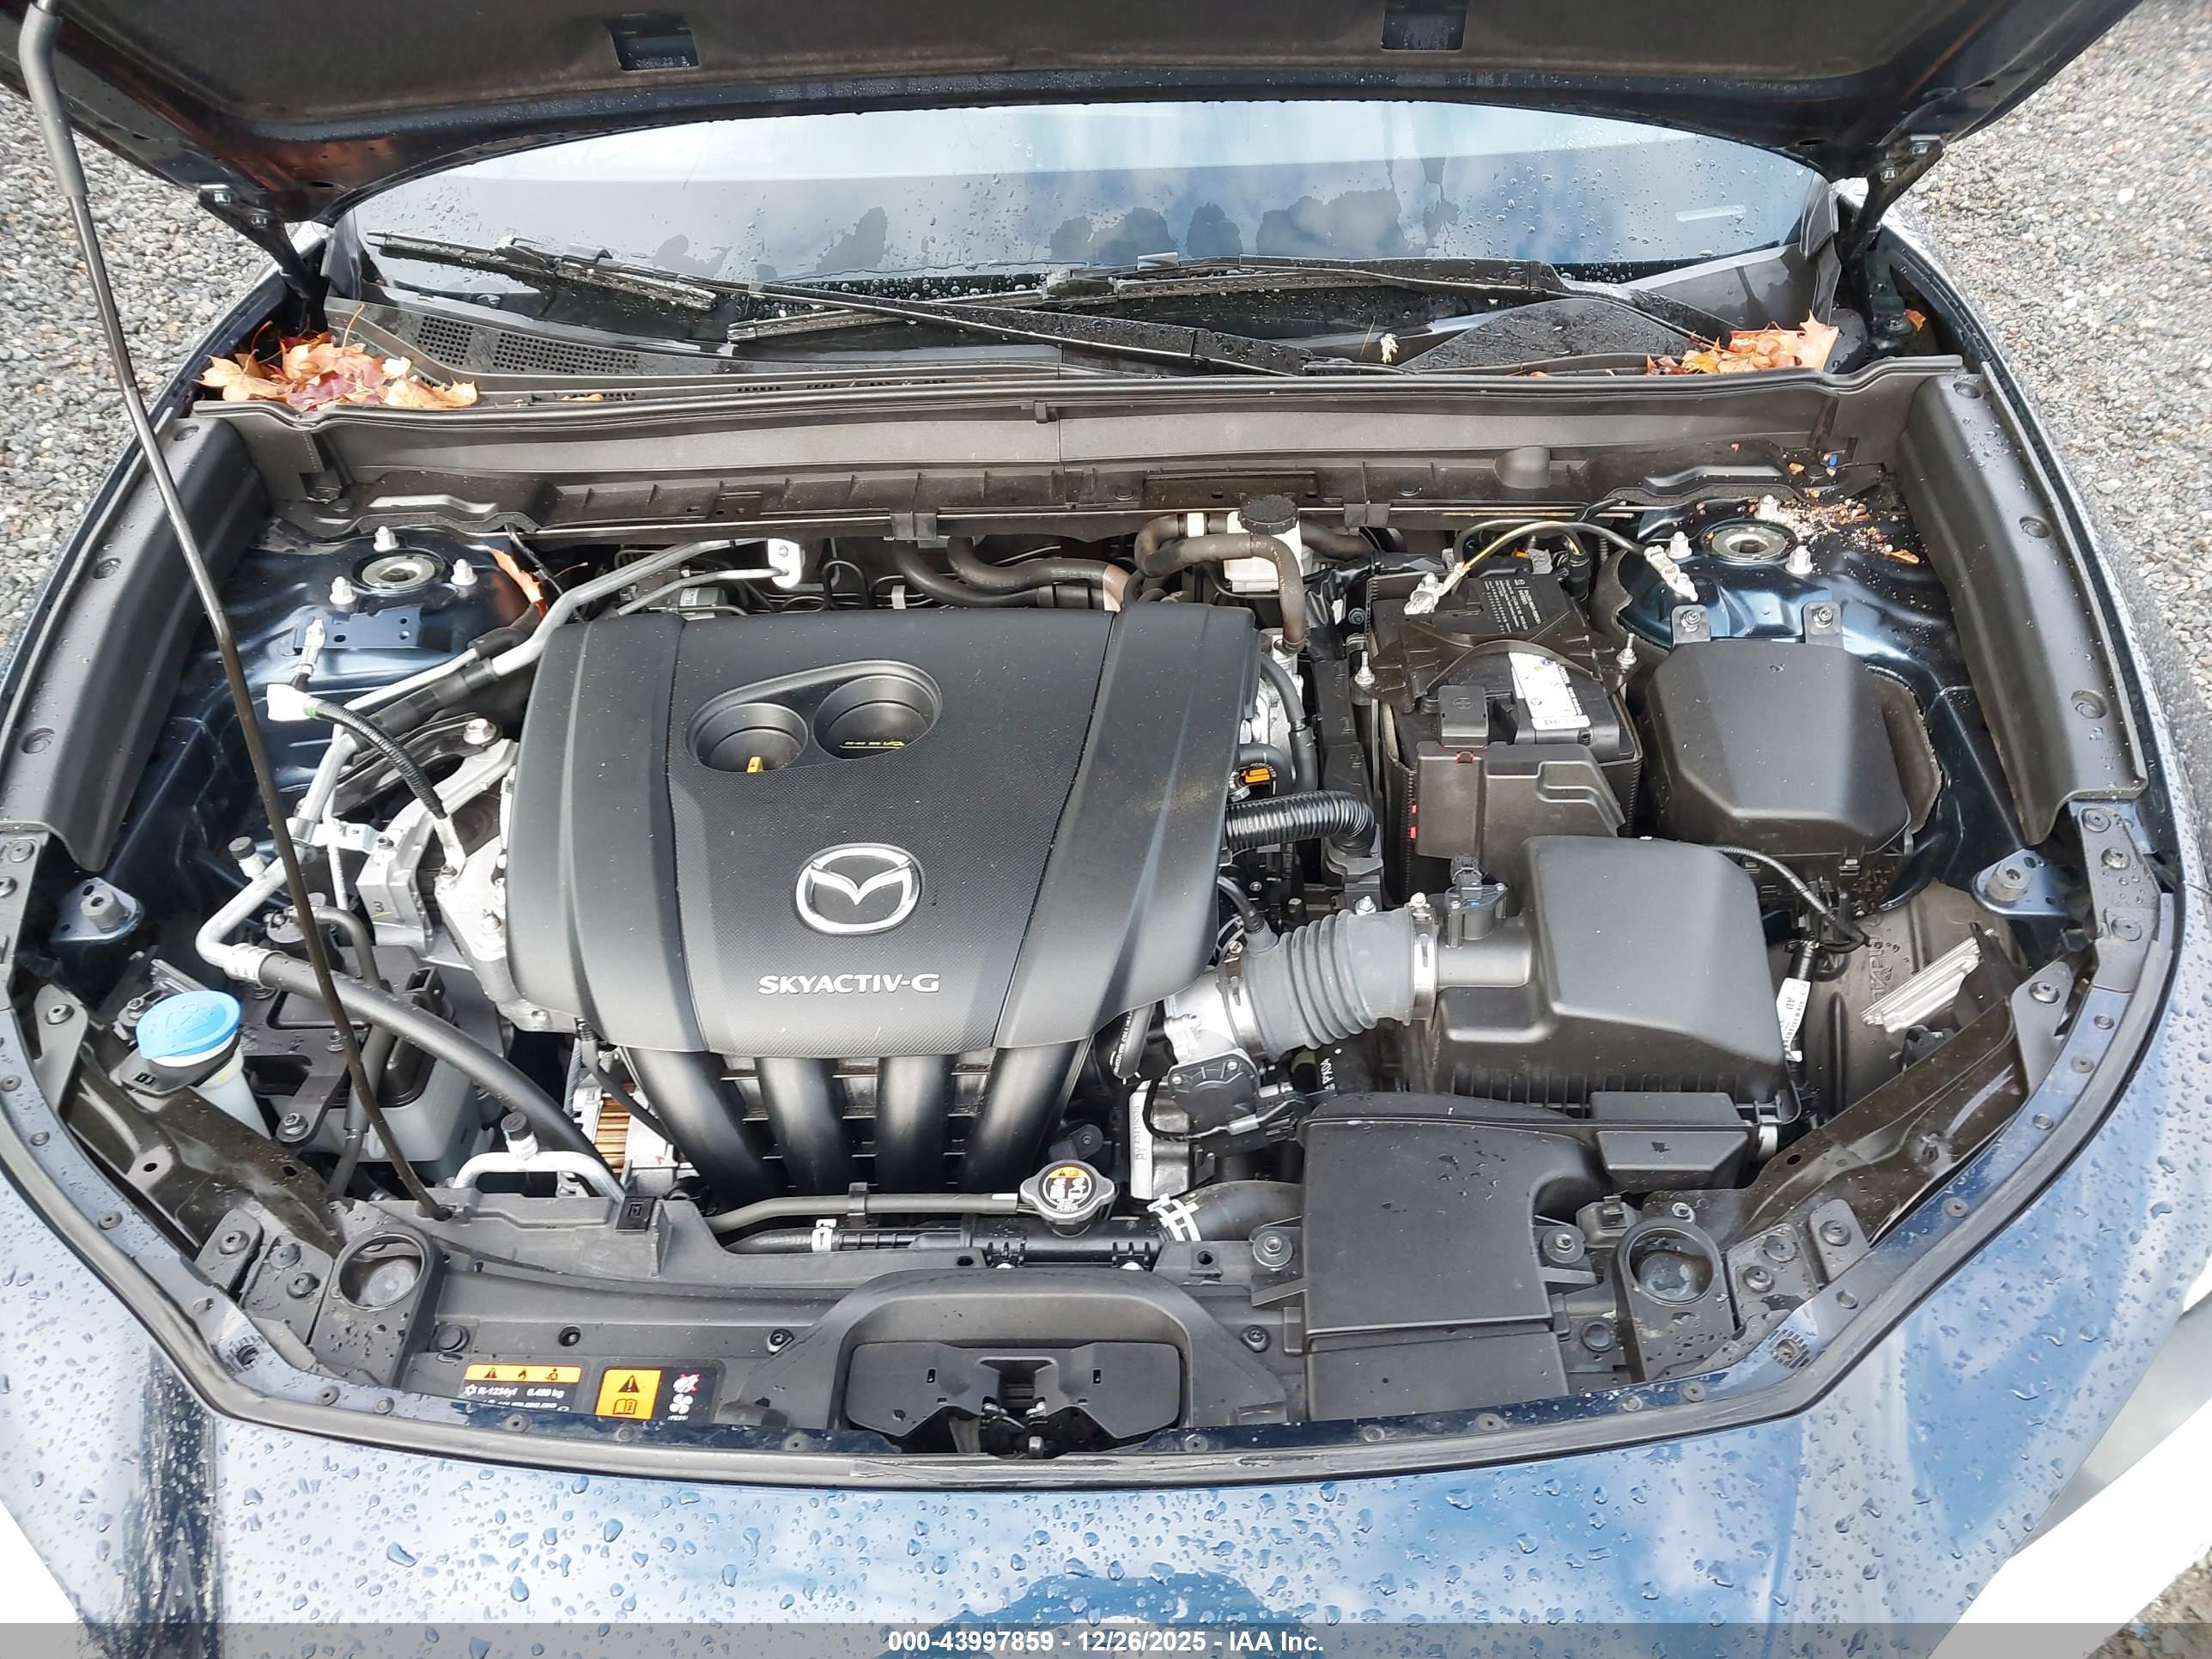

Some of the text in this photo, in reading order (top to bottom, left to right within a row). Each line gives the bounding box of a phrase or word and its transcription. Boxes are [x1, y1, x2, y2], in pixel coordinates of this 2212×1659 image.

[373, 901, 385, 913] 3
[758, 973, 940, 994] SKYACTIV-G
[552, 1389, 564, 1399] kg
